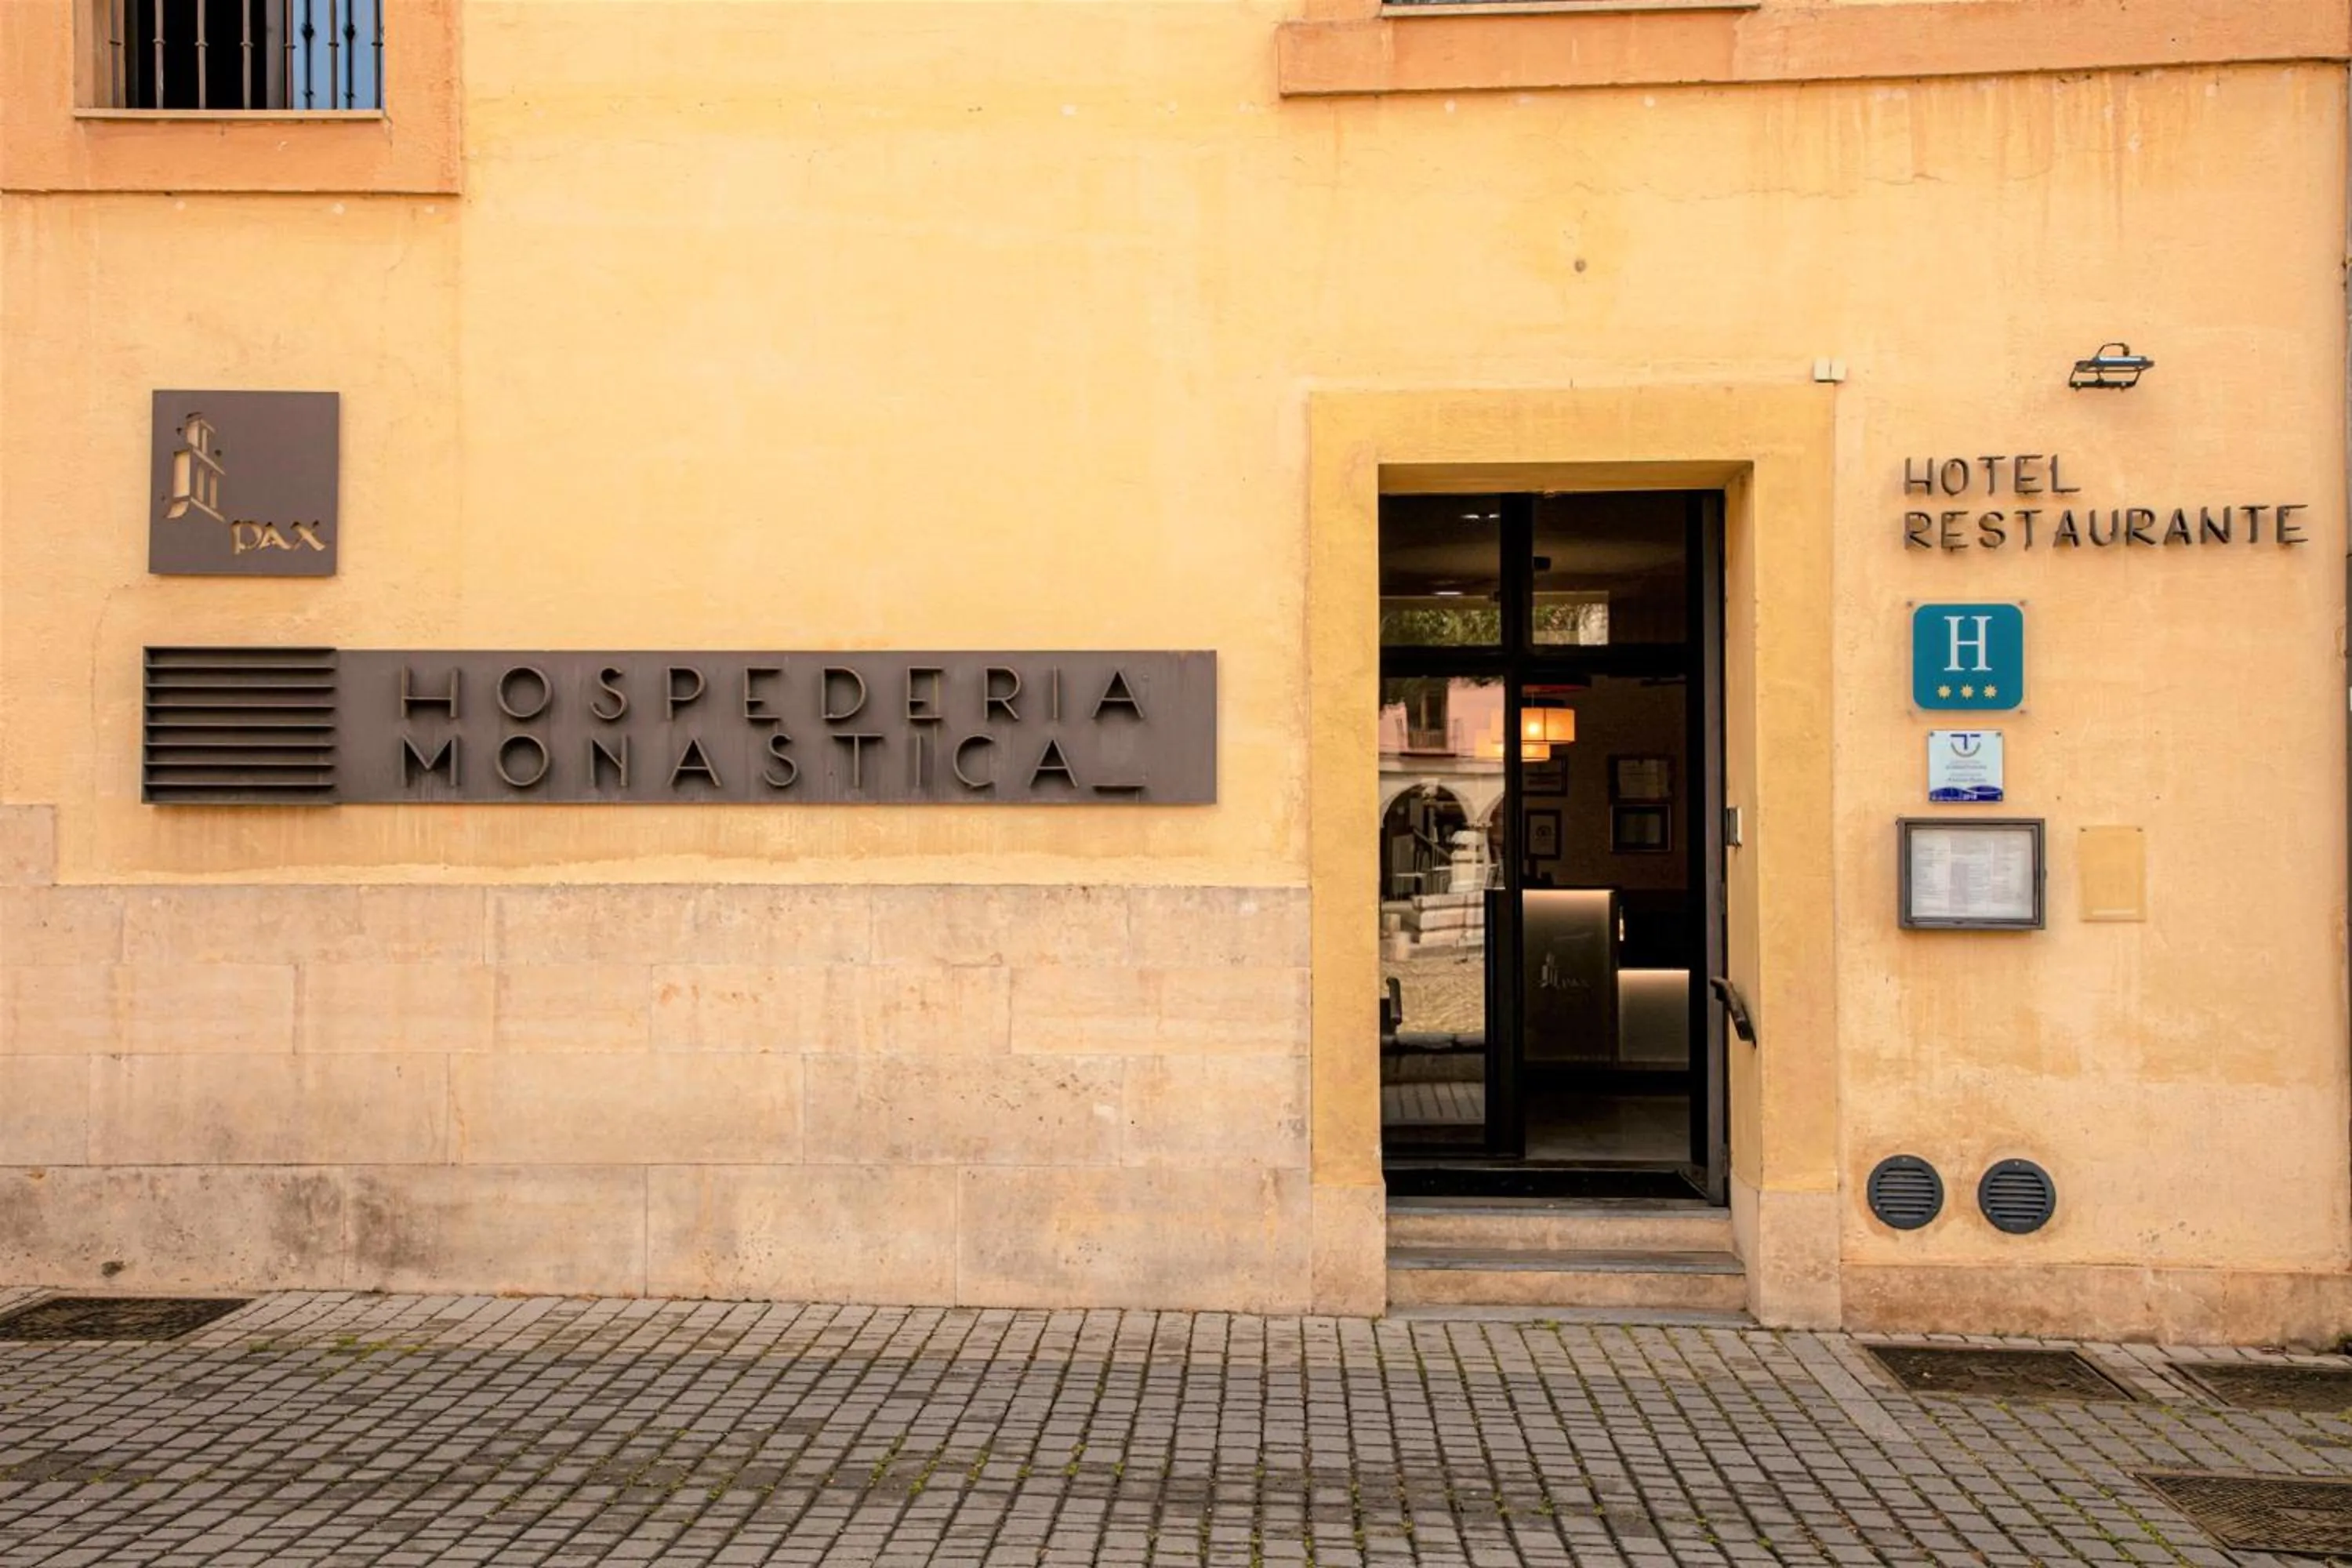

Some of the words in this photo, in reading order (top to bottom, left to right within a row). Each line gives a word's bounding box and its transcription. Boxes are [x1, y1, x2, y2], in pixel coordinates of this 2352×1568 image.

[1904, 453, 2082, 497] HOTEL
[1904, 503, 2310, 551] RESTAURANTE
[1943, 615, 1993, 672] H
[401, 663, 1145, 722] HOSPEDERIA
